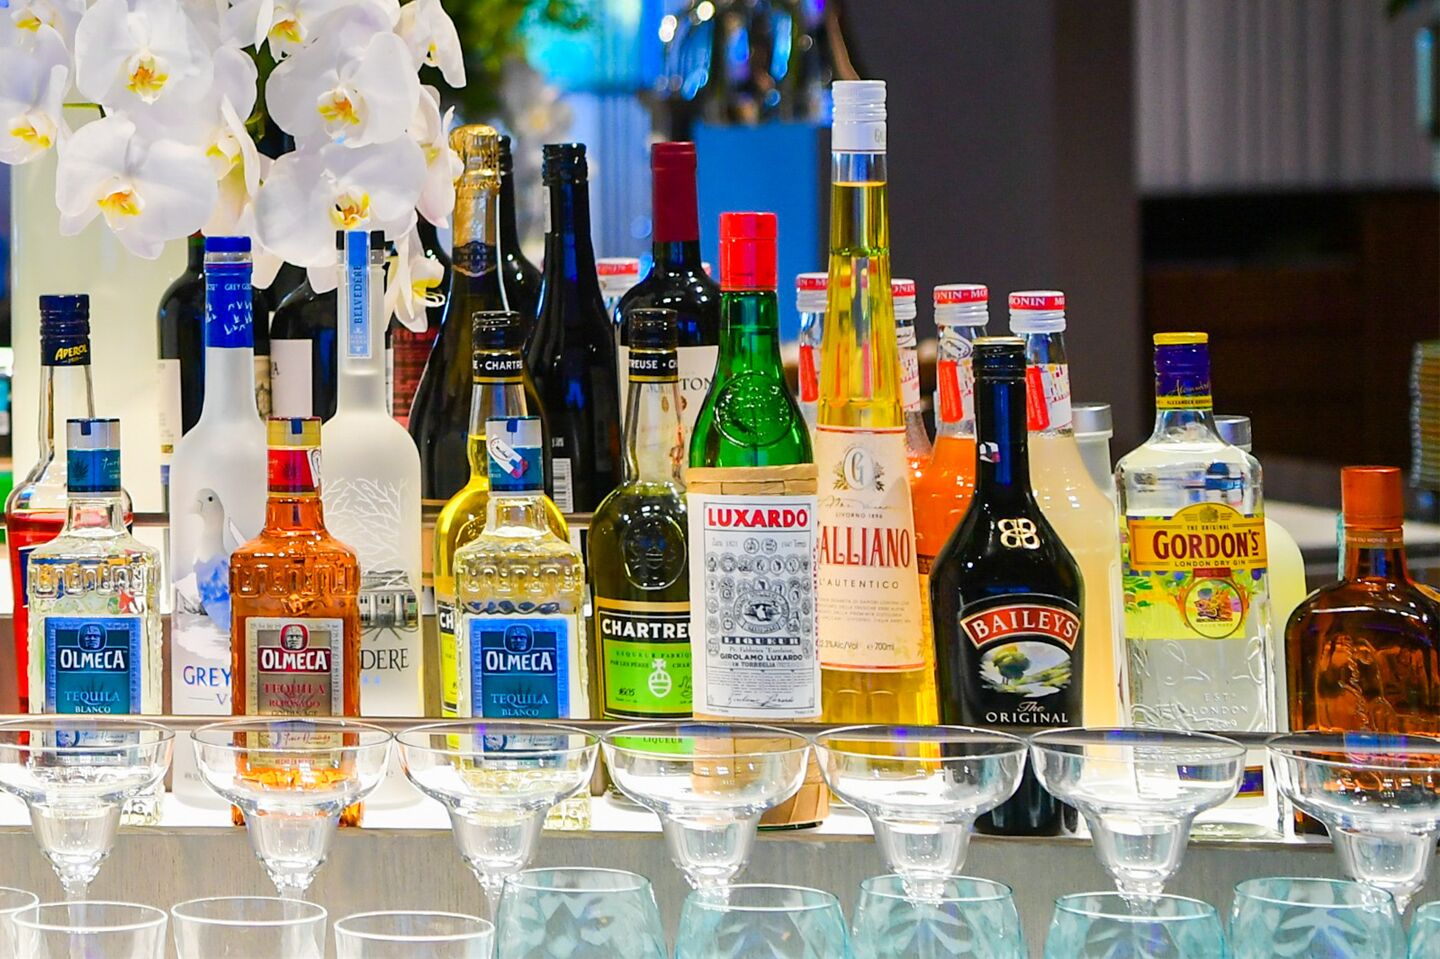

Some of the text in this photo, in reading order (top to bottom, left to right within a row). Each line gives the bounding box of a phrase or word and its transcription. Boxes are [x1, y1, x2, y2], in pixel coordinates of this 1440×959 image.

[353, 264, 363, 325] BELVEDERE
[54, 343, 88, 361] APEROL
[708, 507, 808, 528] LUXARDO
[1152, 529, 1260, 560] GORDON'S
[601, 618, 691, 639] CHARTRE
[971, 609, 1077, 640] BAILEYS
[60, 648, 126, 670] OLMECA
[261, 649, 328, 671] OLMECA
[486, 650, 553, 672] OLMECA
[719, 652, 803, 661] GIROLAMO LUXARDO
[63, 690, 120, 706] TEQUILA
[263, 683, 326, 700] TEQUILA
[490, 692, 549, 709] TEQUILA
[75, 705, 112, 714] BLANCO
[501, 708, 540, 717] BLANCO
[1016, 700, 1046, 713] The
[985, 711, 1069, 724] ORIGINAL
